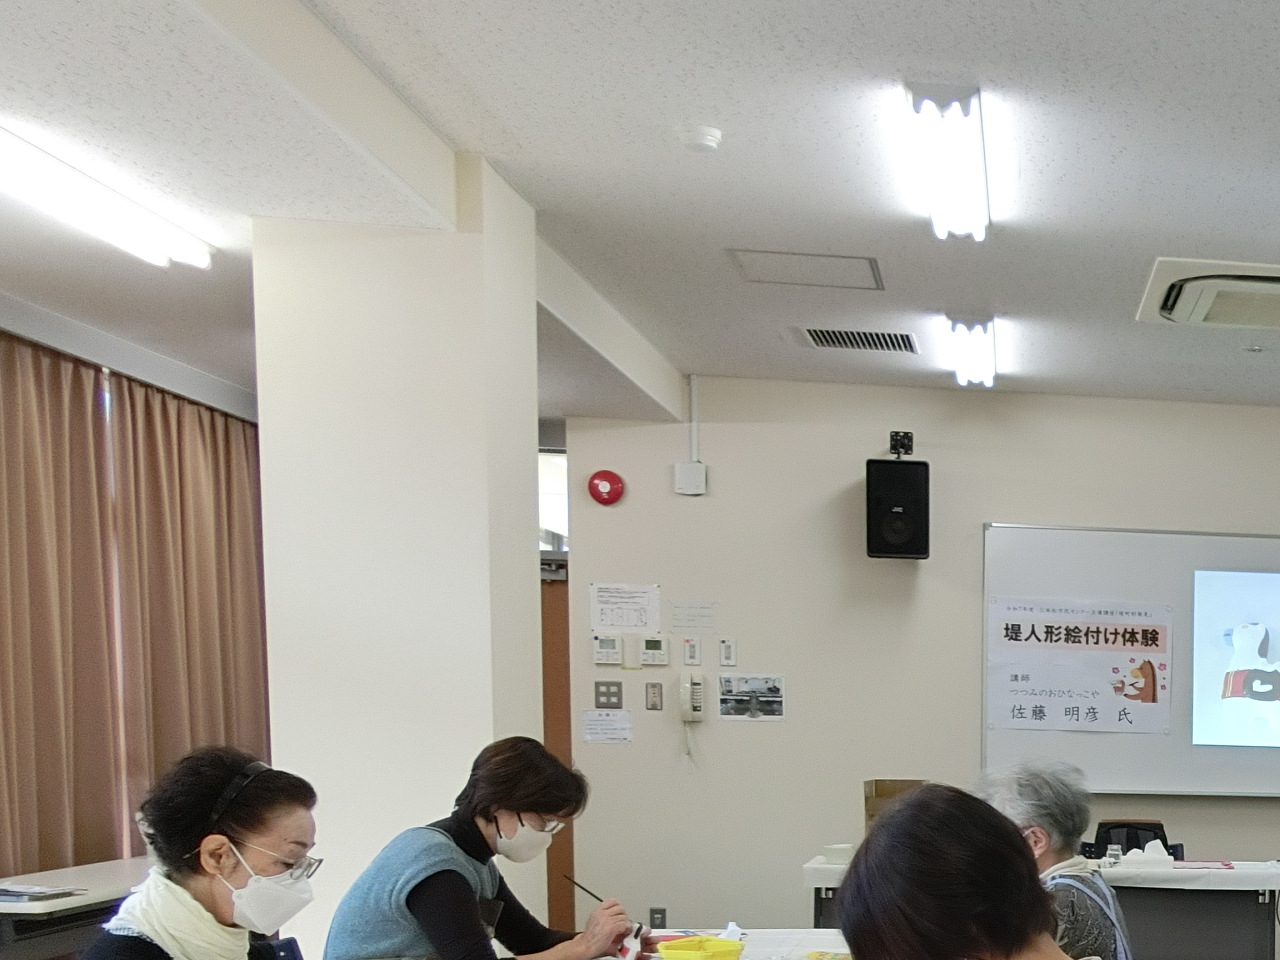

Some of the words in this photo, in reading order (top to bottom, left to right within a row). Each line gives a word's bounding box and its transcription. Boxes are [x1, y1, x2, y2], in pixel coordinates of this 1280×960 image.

[1003, 623, 1160, 648] 堤人形絵付け体験
[1010, 674, 1031, 683] 講師
[1009, 688, 1100, 700] つつみのおひなっこや
[1010, 704, 1048, 721] 佐藤
[1064, 705, 1100, 723] 明彦
[1117, 707, 1133, 725] 氏
